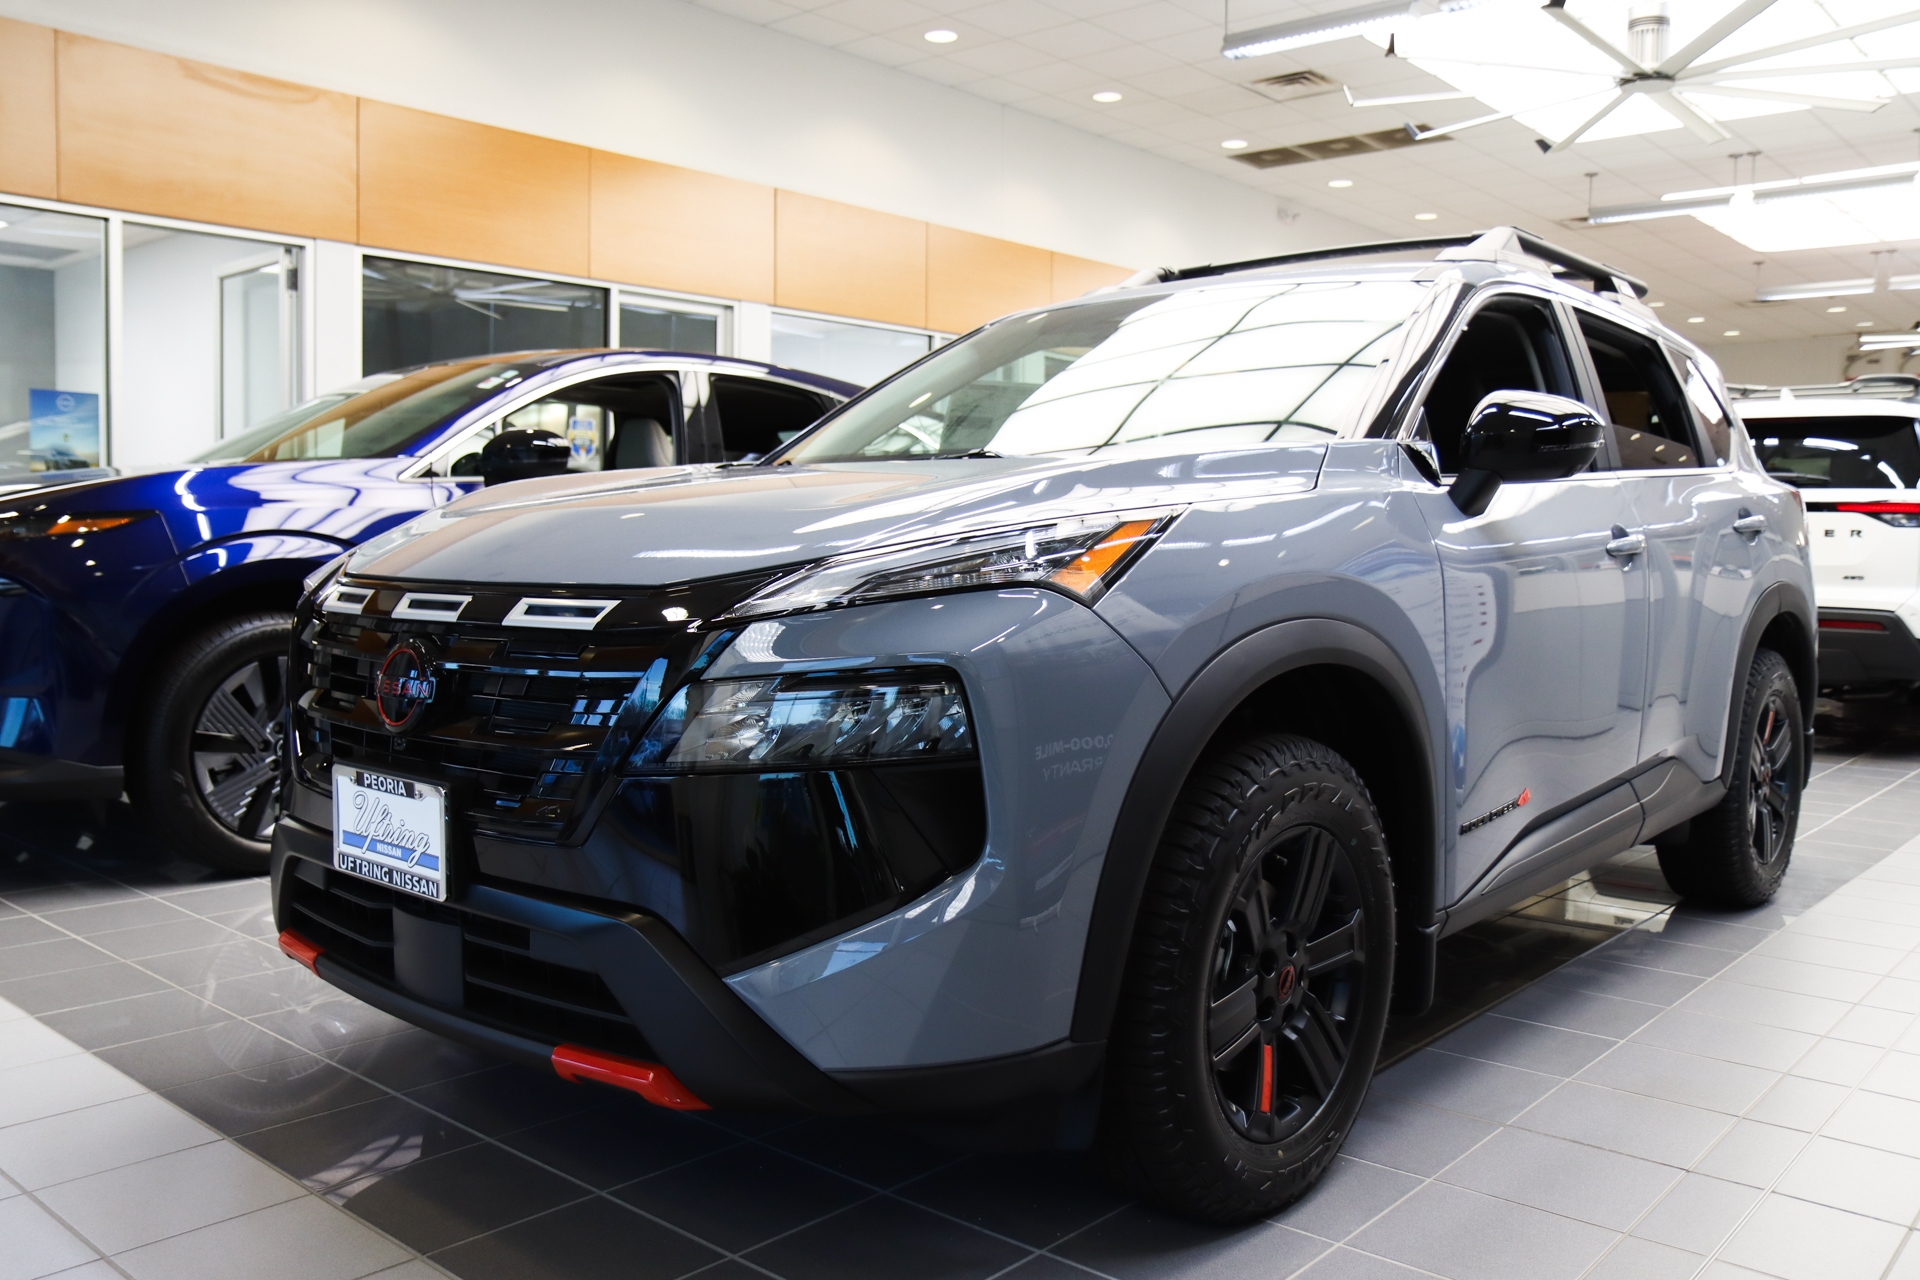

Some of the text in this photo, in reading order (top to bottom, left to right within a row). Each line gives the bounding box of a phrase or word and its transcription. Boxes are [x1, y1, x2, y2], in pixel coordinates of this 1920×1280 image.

[376, 679, 430, 698] SSAN
[363, 773, 407, 797] PEORIA
[353, 790, 430, 868] Uftring
[376, 842, 402, 858] NISSAN
[339, 854, 438, 898] UFTRING NISSAN
